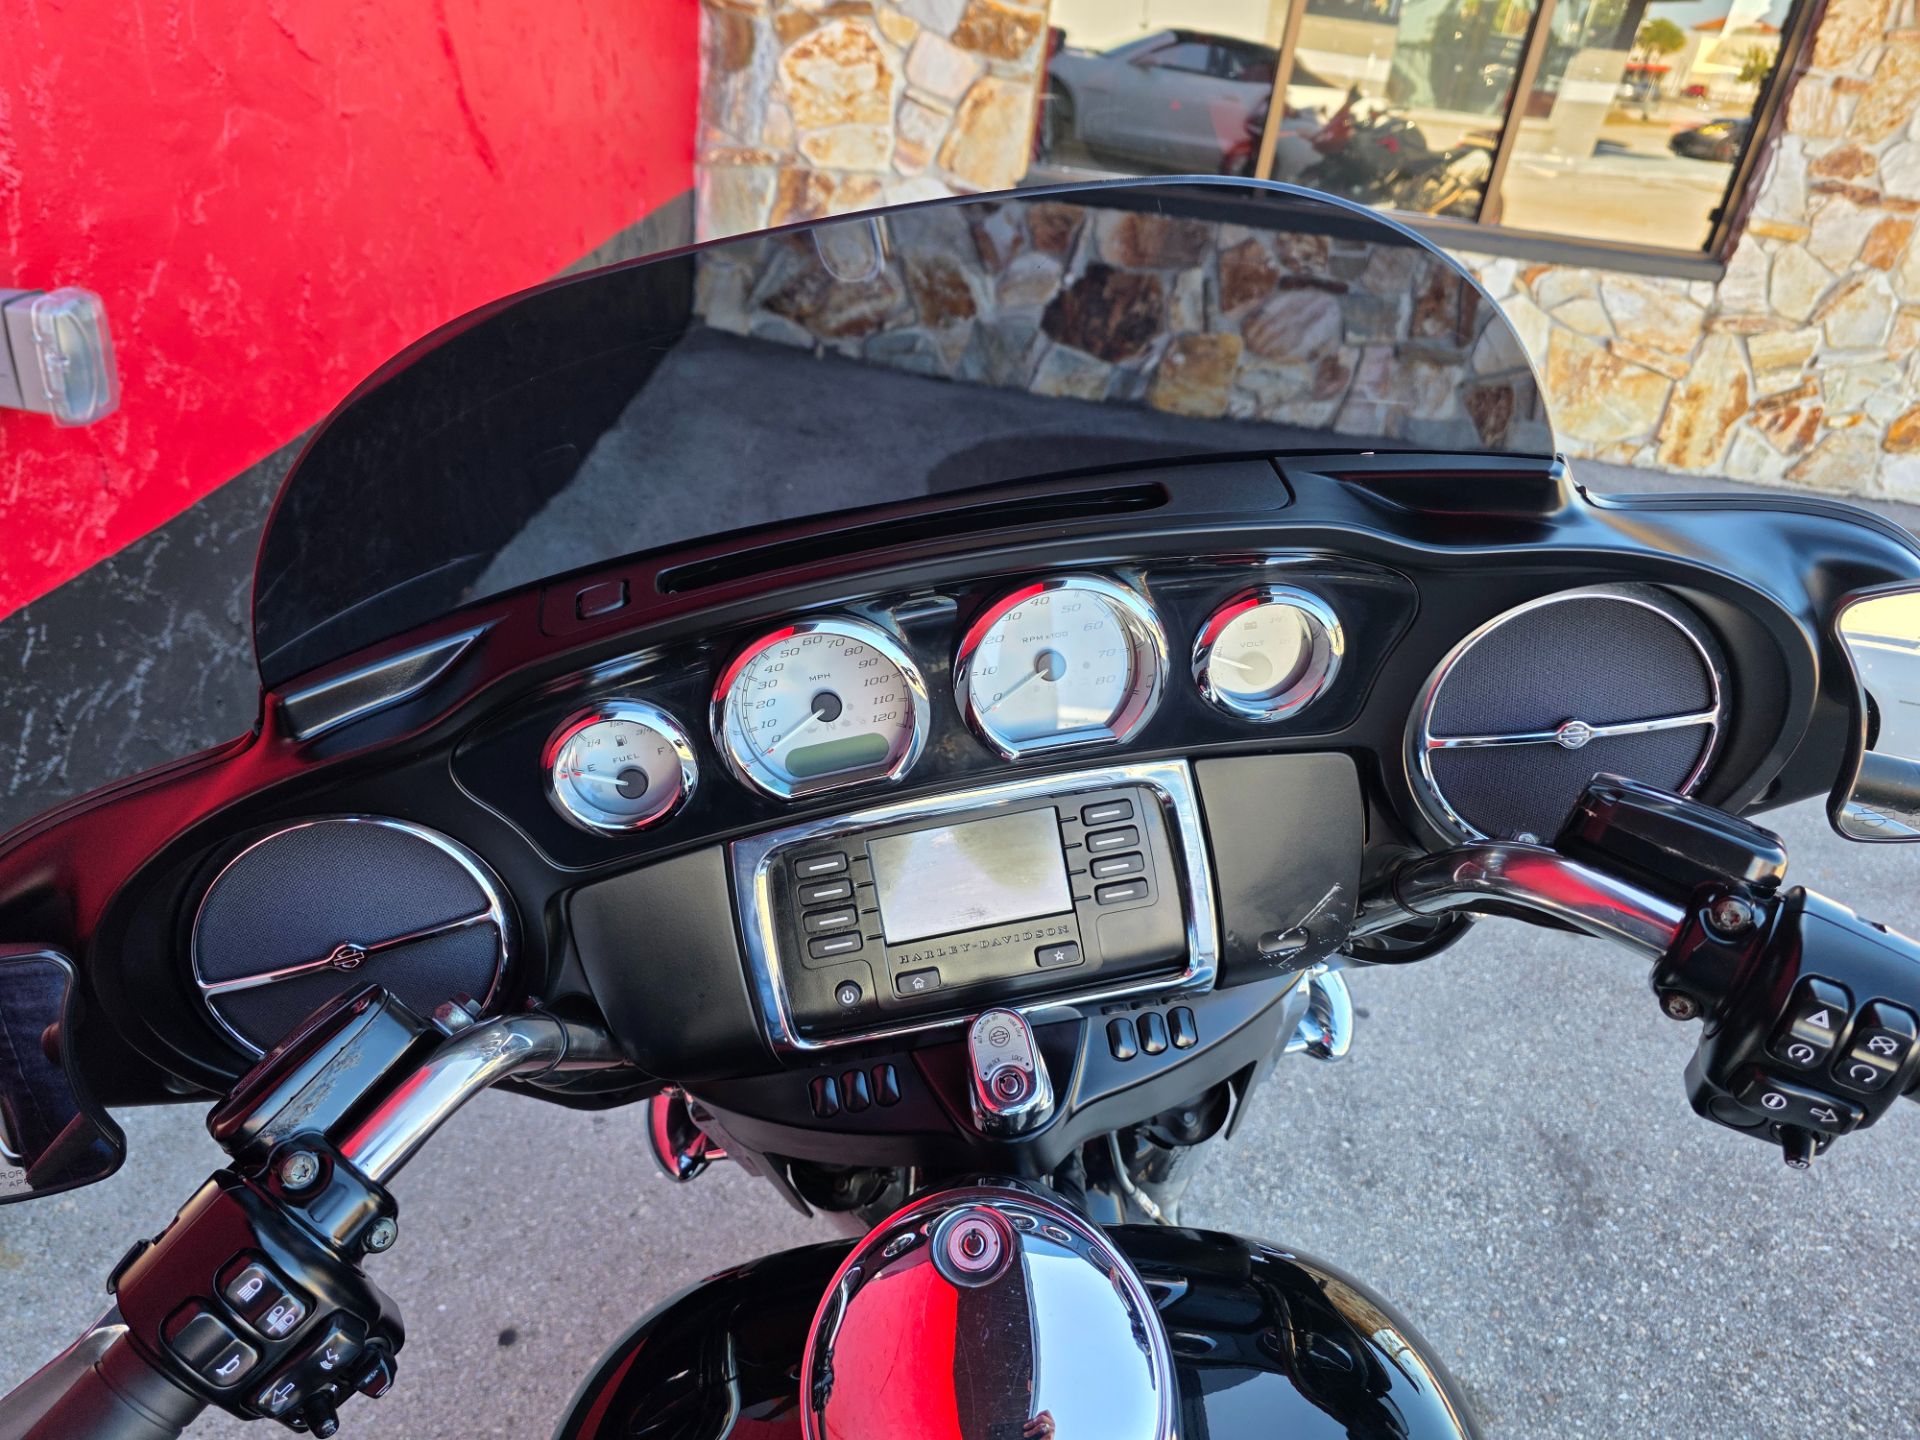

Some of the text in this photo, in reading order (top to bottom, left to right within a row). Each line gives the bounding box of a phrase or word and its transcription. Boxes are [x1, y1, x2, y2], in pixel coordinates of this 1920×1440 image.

[1030, 596, 1050, 607] 40
[1060, 603, 1081, 614] 50
[1003, 611, 1023, 622] 30
[1083, 621, 1103, 632] 60
[802, 635, 823, 647] 60
[827, 637, 846, 649] 70
[985, 634, 1005, 645] 20
[1022, 634, 1044, 644] RPM
[1240, 639, 1265, 648] VOLT
[780, 647, 800, 659] 50
[843, 645, 863, 657] 80
[1098, 648, 1117, 658] 70
[764, 662, 784, 673] 40
[858, 658, 878, 669] 90
[981, 666, 998, 676] 10
[808, 672, 831, 682] MPH
[863, 675, 889, 687] 100
[1095, 674, 1116, 685] 80
[758, 679, 778, 691] 30
[873, 693, 895, 705] 110
[993, 692, 1003, 702] 0
[755, 698, 776, 709] 20
[872, 711, 897, 723] 120
[761, 718, 777, 729] 10
[772, 734, 782, 743] 0
[657, 747, 665, 755] F
[612, 752, 640, 764] FUEL
[587, 763, 596, 772] E
[899, 925, 1070, 964] HARLEY-DAVIDSON
